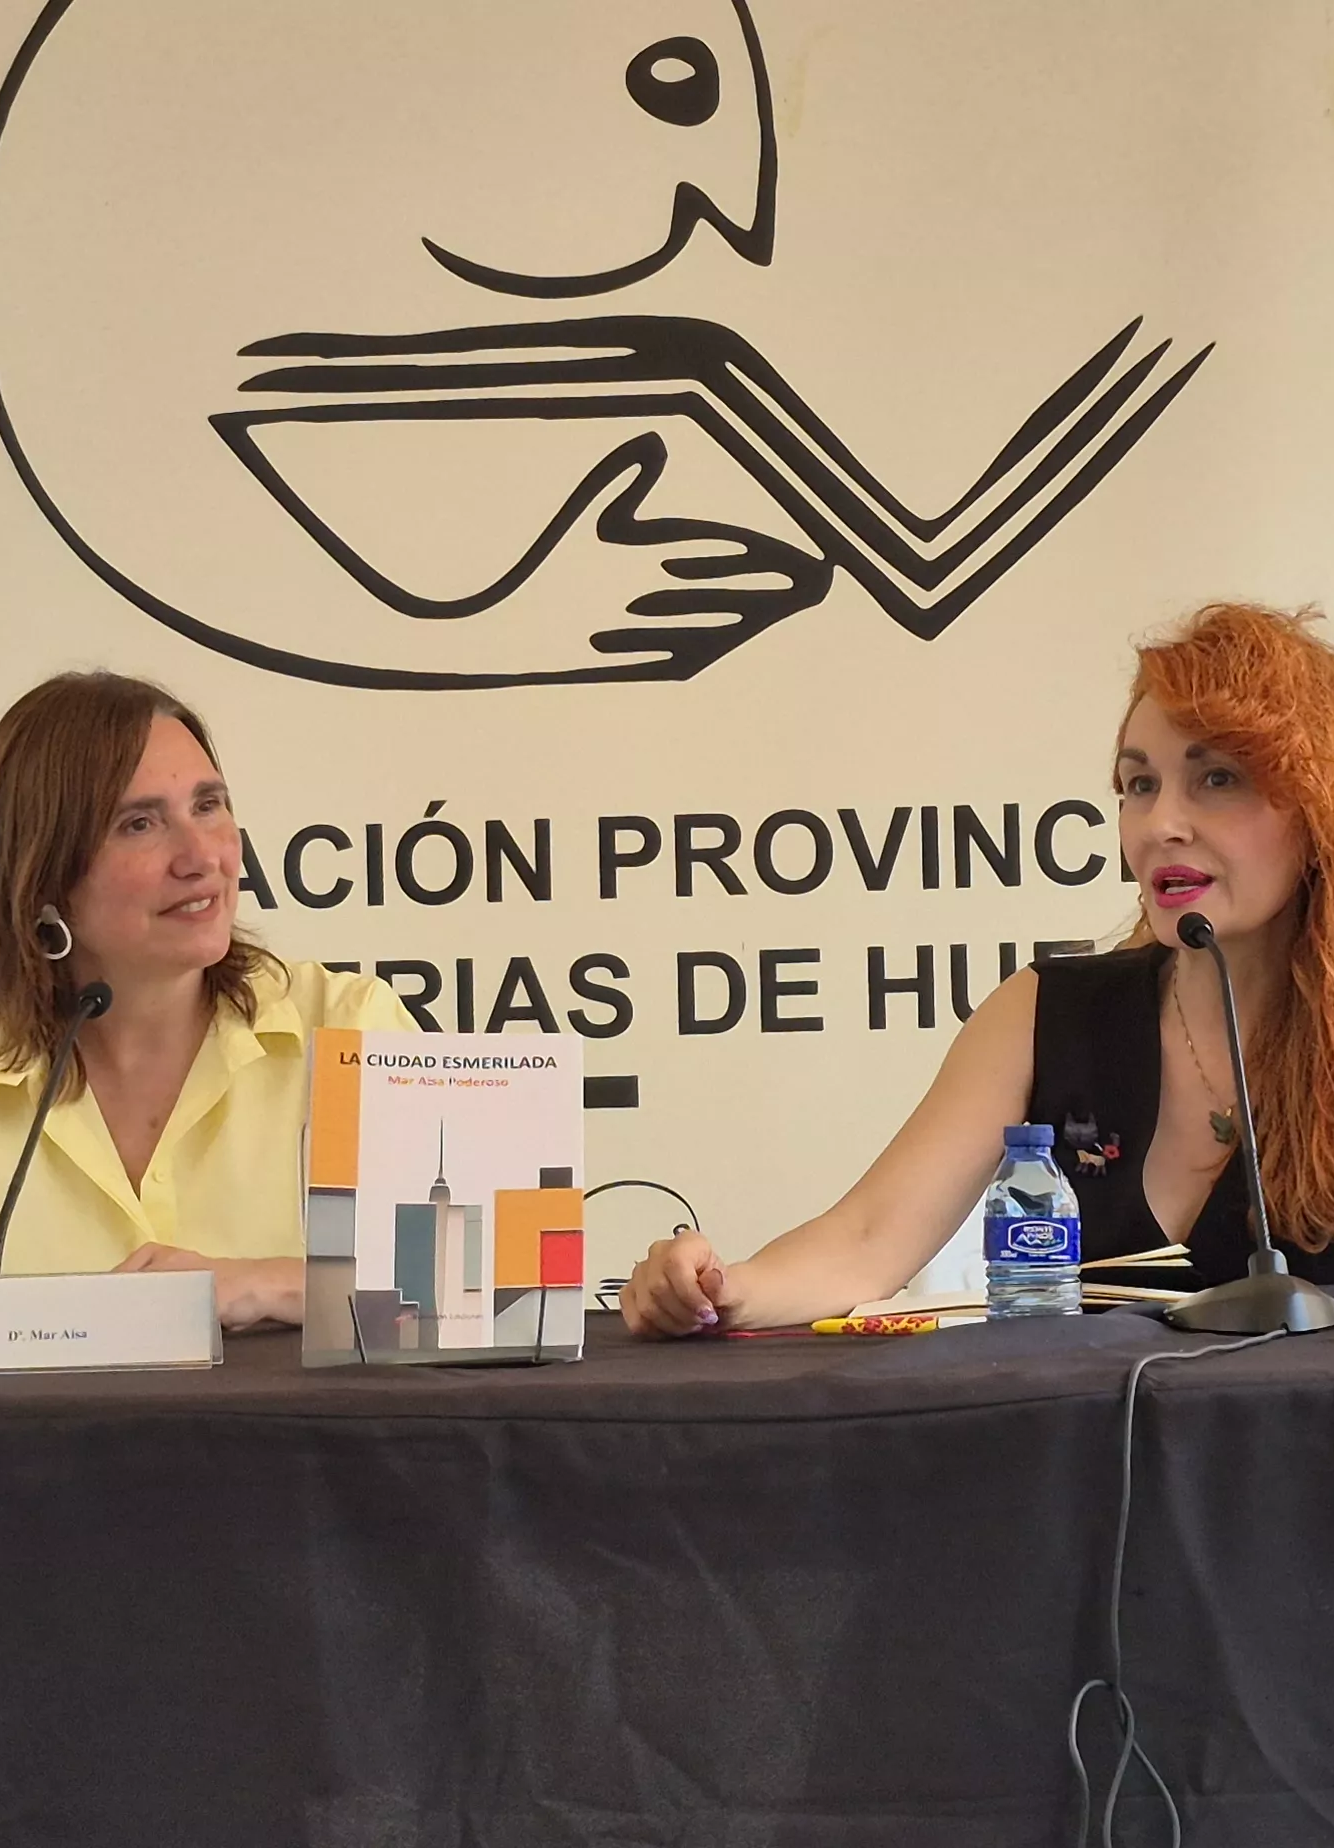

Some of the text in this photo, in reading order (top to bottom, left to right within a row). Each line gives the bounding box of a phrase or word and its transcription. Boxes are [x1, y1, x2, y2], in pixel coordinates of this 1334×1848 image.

[676, 948, 825, 1036] DE
[339, 1051, 558, 1070] LA CIUDAD ESMERILADA
[387, 1074, 415, 1086] Mar
[448, 1076, 510, 1088] Poderoso
[30, 1329, 57, 1341] Mar
